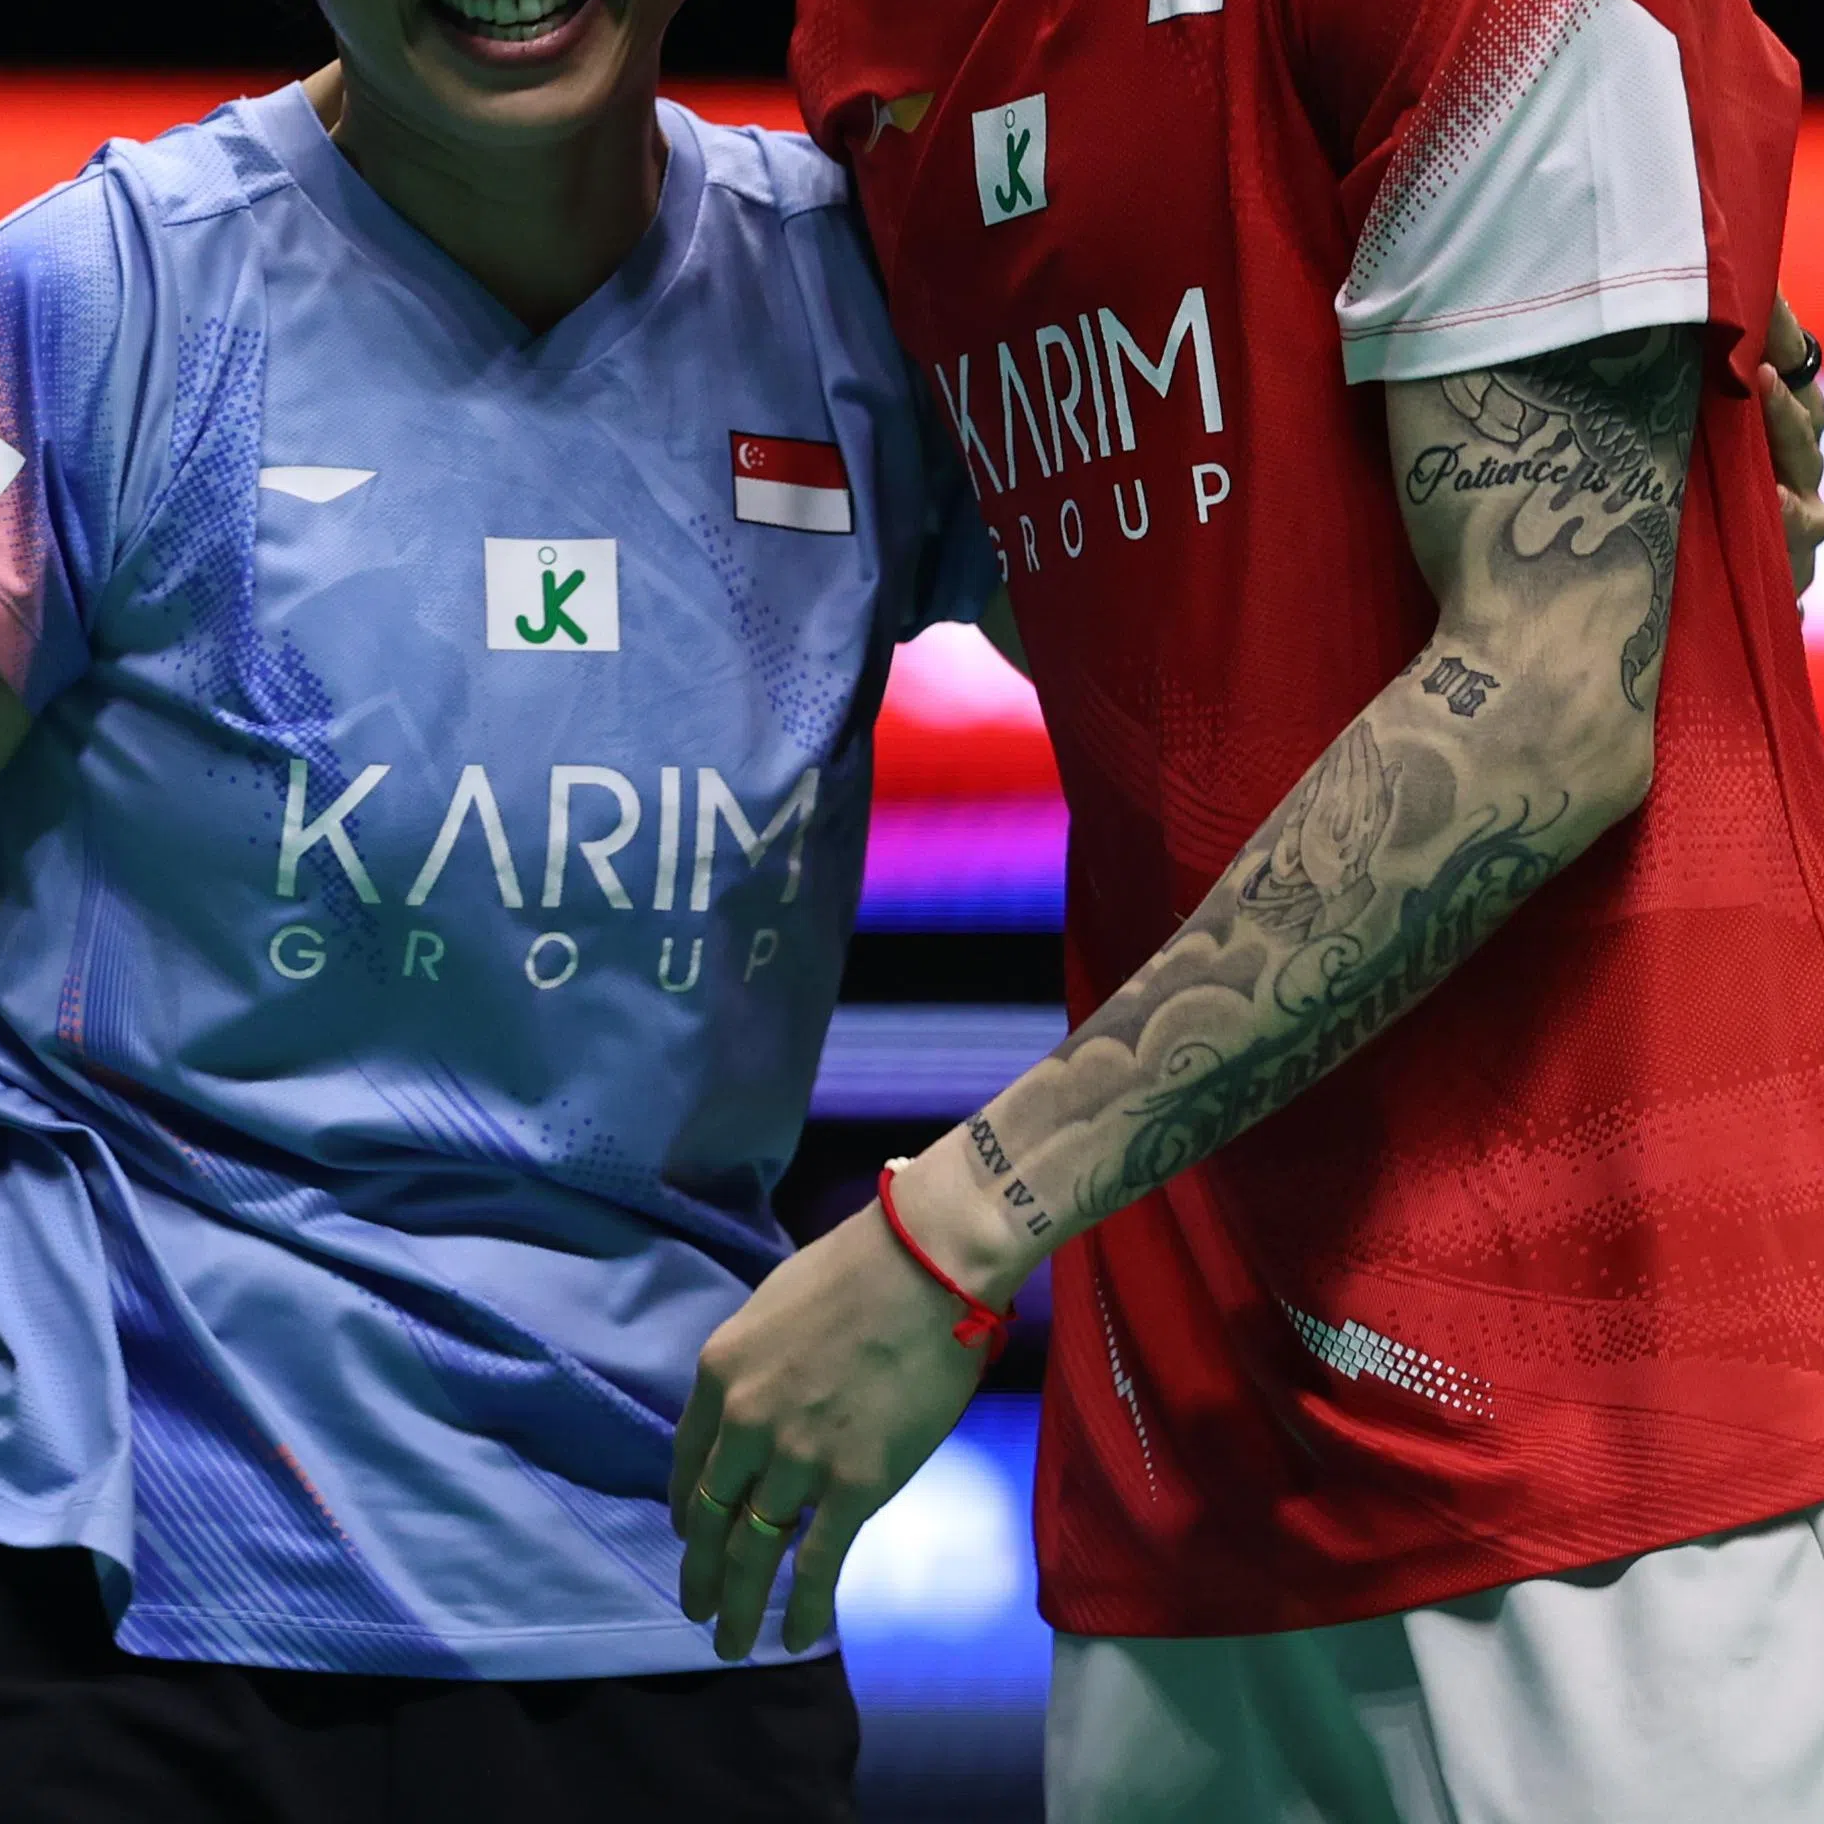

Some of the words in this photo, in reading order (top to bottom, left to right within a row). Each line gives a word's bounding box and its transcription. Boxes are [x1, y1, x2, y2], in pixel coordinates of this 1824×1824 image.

[934, 285, 1224, 501] KARIM
[1405, 442, 1569, 506] Patience
[1580, 461, 1610, 494] is
[1620, 465, 1664, 504] the
[275, 758, 821, 912] KARIM
[268, 924, 779, 993] GROUP
